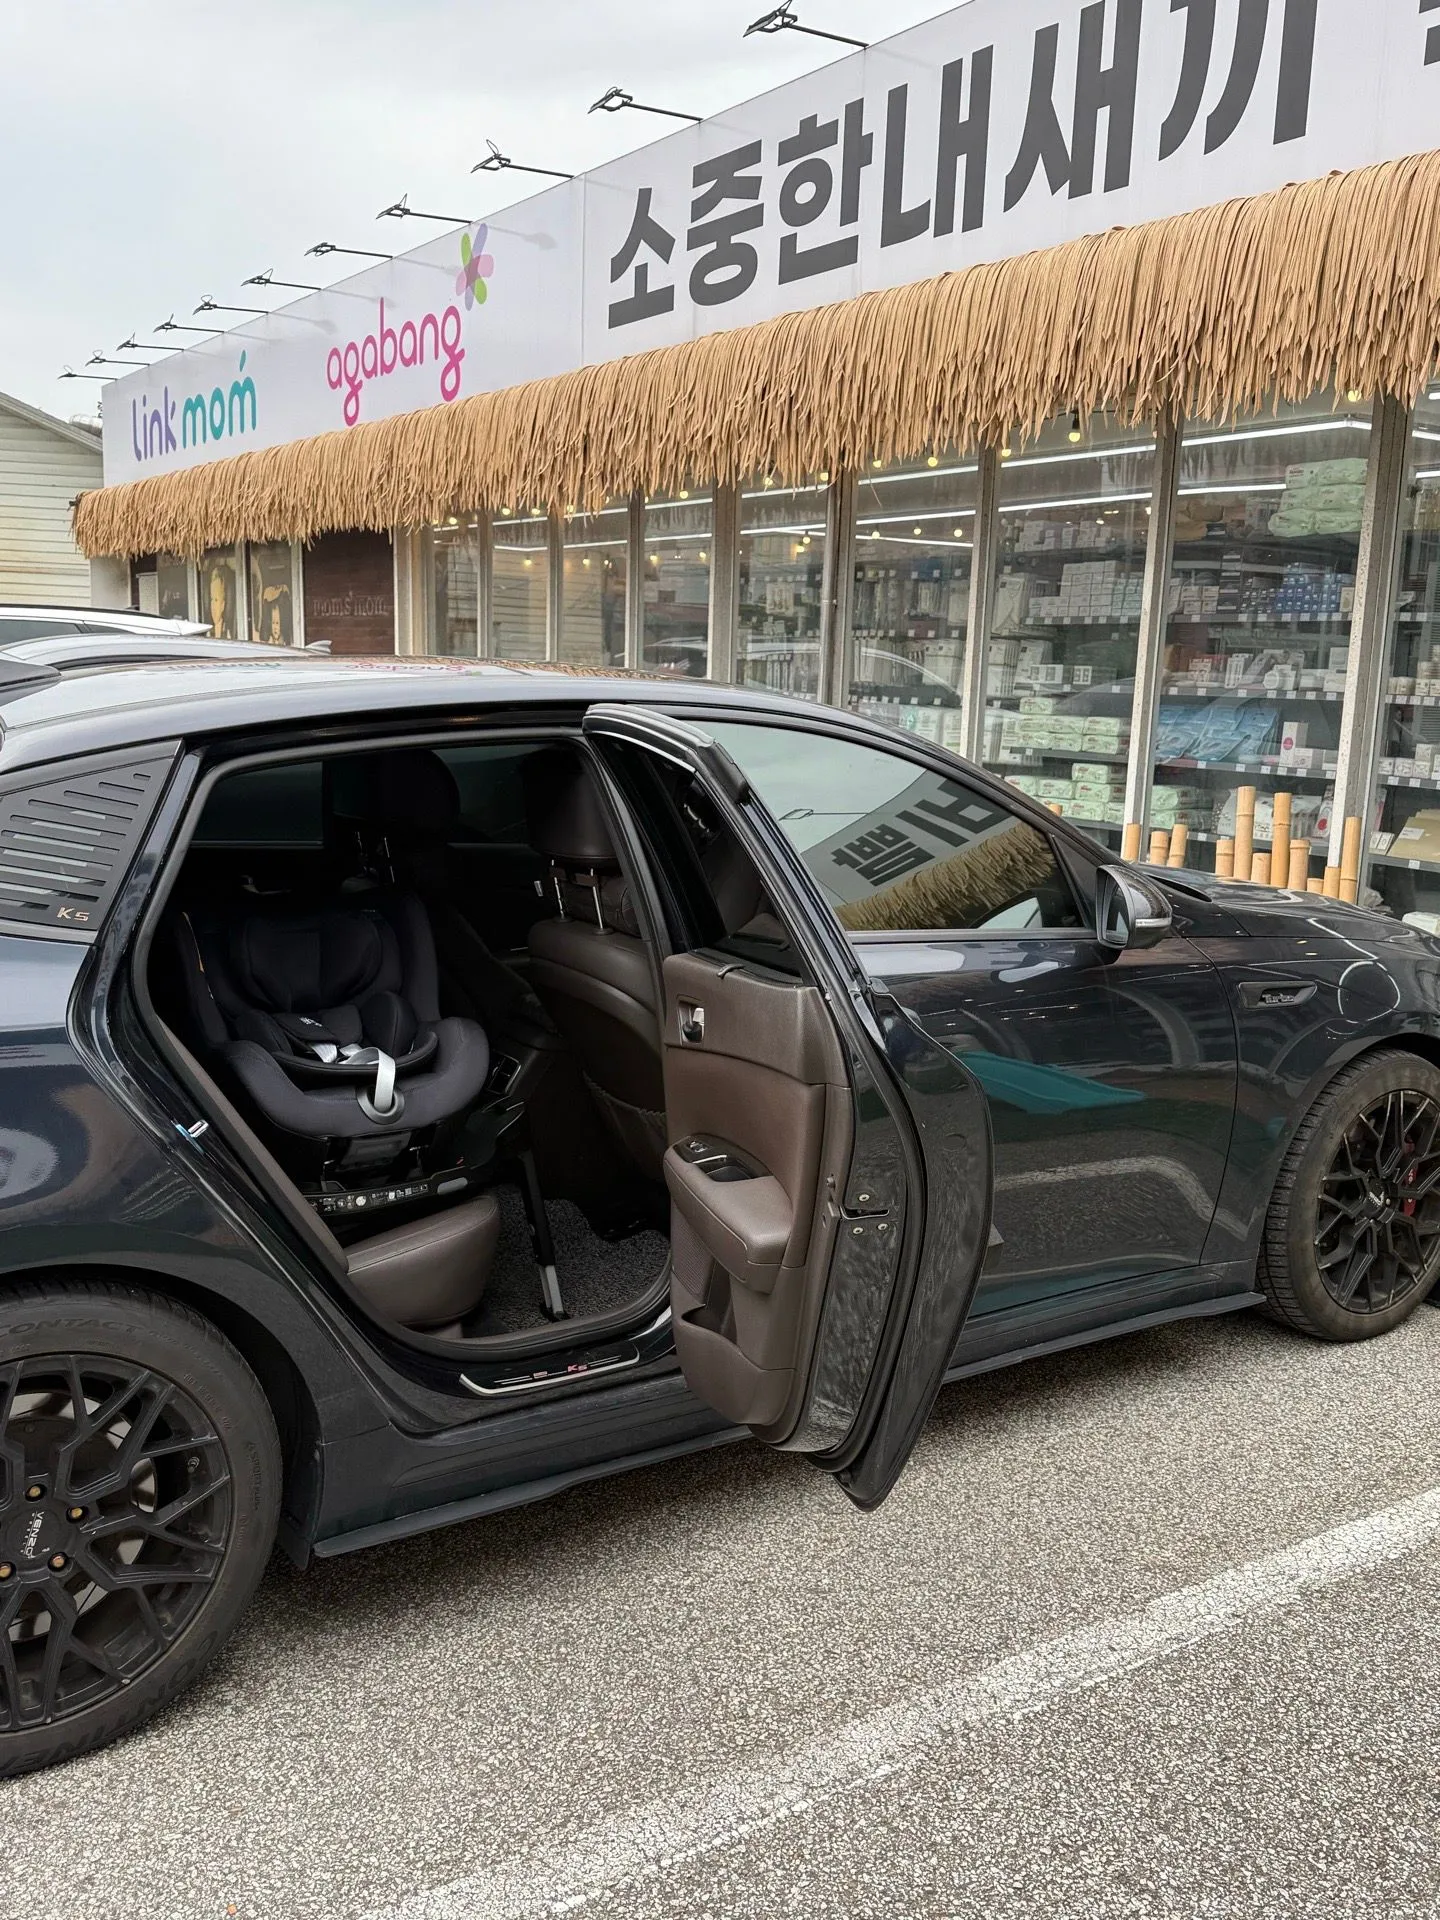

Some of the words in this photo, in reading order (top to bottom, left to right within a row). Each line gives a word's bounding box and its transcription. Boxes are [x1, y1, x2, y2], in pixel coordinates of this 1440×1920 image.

[326, 296, 466, 427] agabang
[132, 385, 177, 462] link
[57, 906, 91, 922] K5
